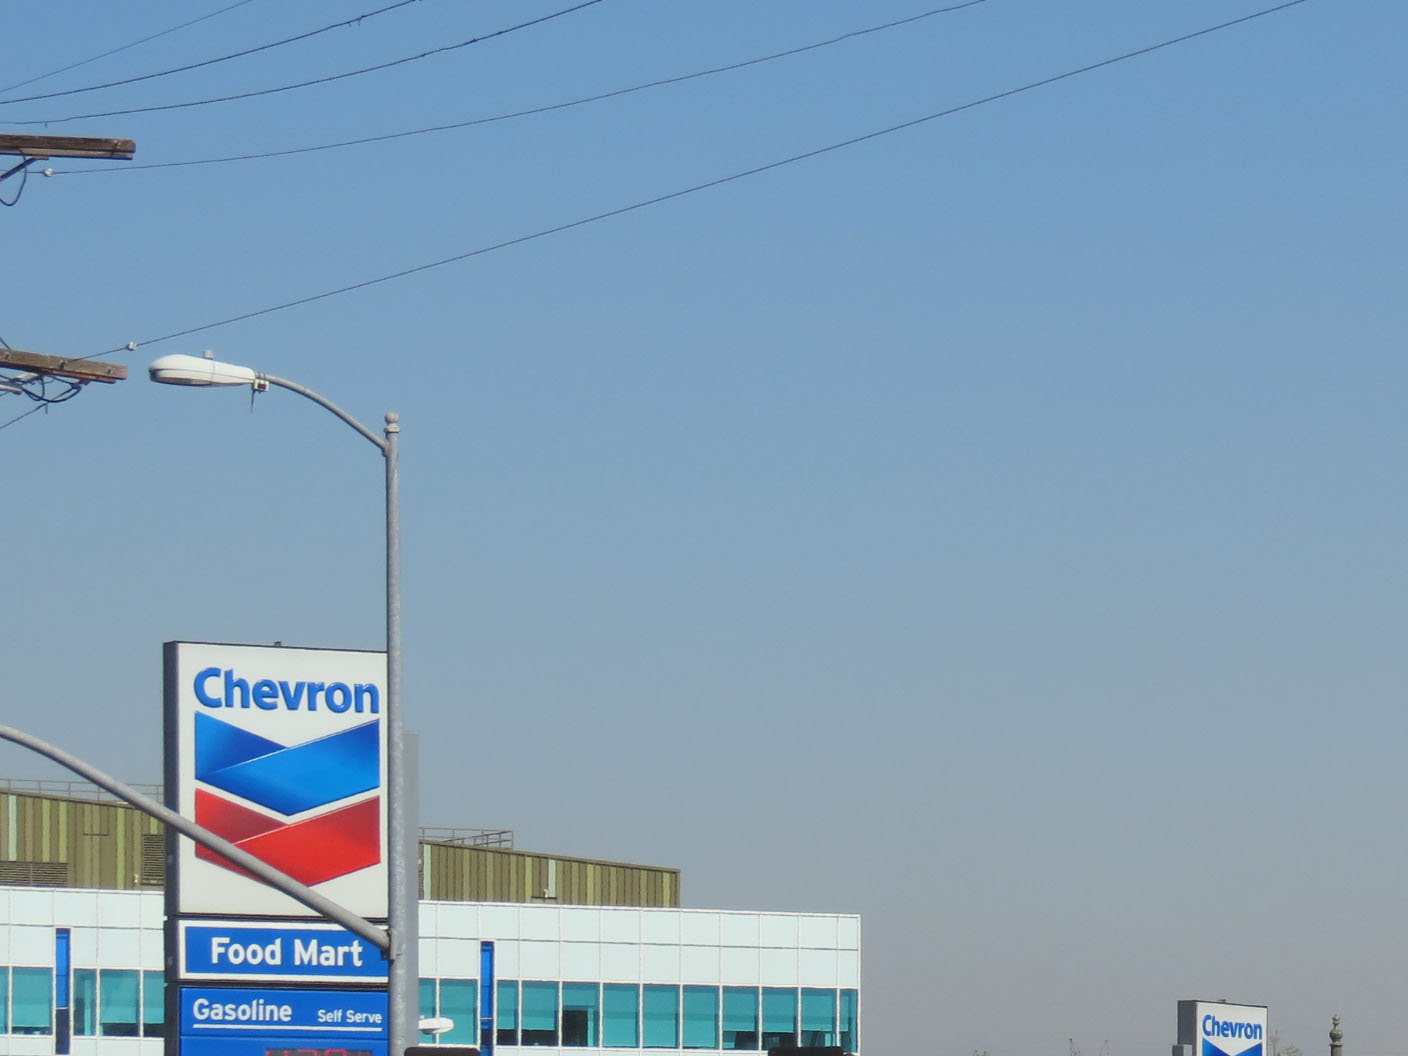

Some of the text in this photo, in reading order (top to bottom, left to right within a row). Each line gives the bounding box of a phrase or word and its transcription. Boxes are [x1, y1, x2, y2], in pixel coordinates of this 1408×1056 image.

[193, 666, 380, 714] Chevron
[211, 937, 363, 967] Food Mart
[193, 998, 292, 1022] Gasoline
[317, 1009, 383, 1024] Self Serve
[1202, 1014, 1263, 1040] Chevron
